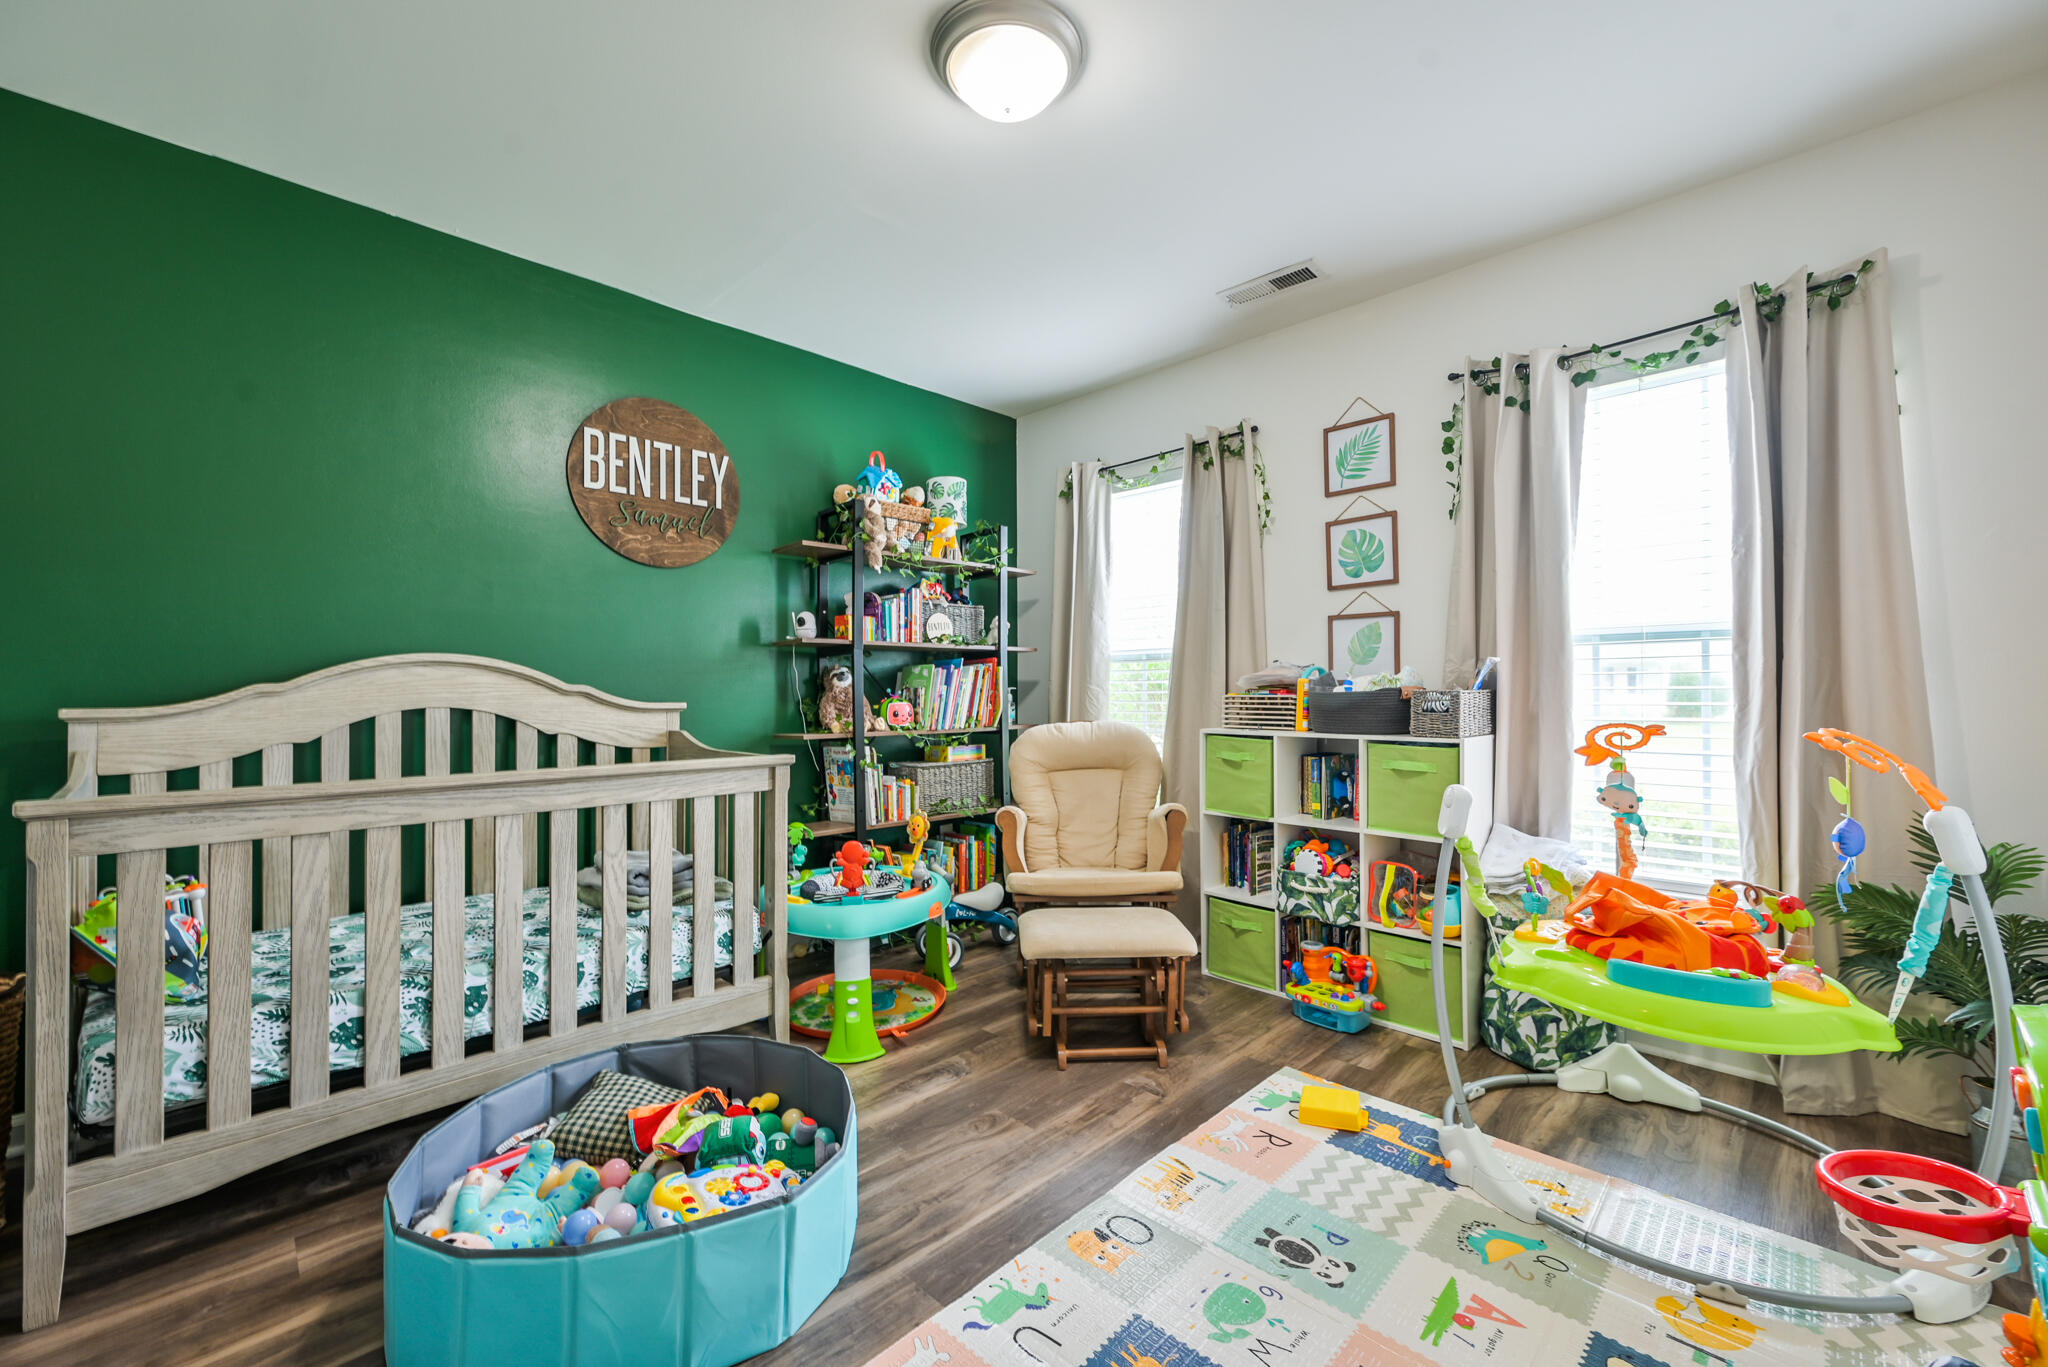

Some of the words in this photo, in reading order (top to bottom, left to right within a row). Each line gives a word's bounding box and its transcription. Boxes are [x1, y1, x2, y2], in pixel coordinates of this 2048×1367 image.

[583, 426, 729, 509] BENTLEY
[610, 500, 716, 538] Samuel
[1252, 1130, 1292, 1147] R
[1106, 1215, 1154, 1245] O
[1532, 1255, 1569, 1272] Q
[1050, 1303, 1080, 1328] Unicorn
[1463, 1293, 1528, 1329] A
[1013, 1326, 1062, 1363] U
[1484, 1328, 1504, 1357] Alligator
